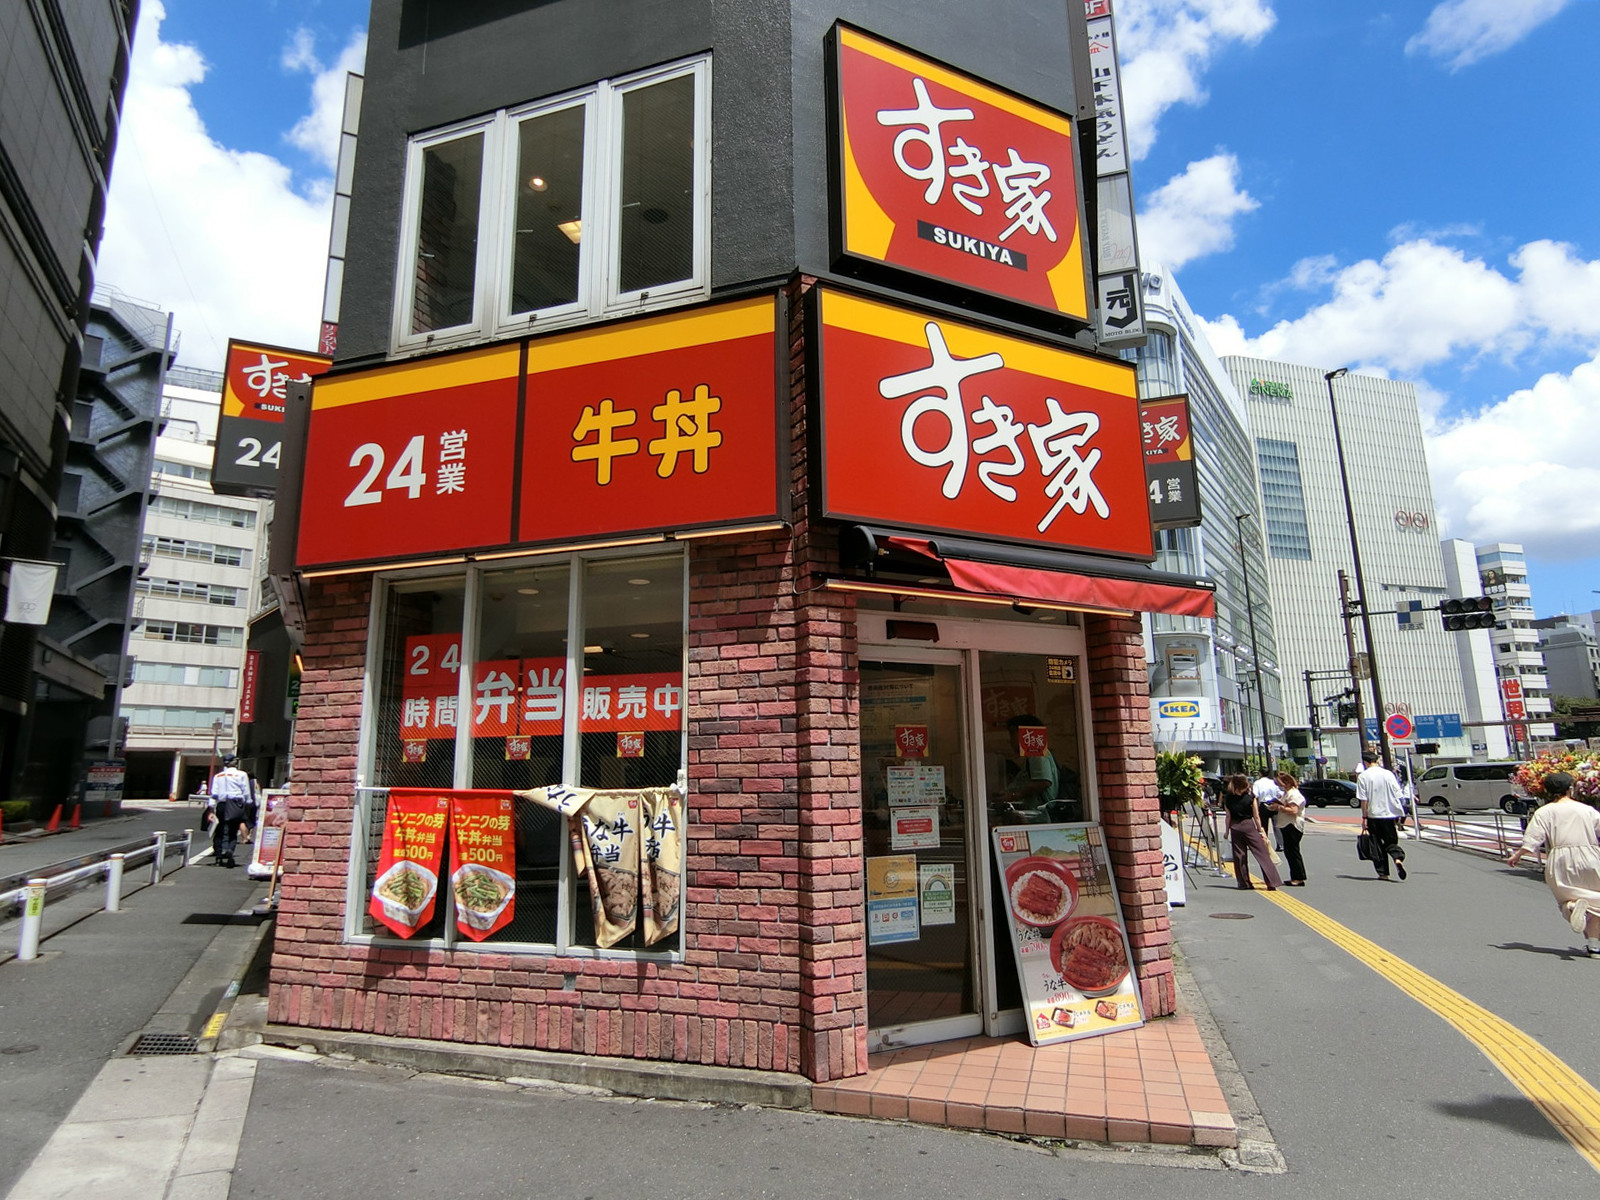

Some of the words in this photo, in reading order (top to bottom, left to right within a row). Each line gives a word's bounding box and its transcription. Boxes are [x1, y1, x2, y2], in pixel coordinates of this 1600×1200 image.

[876, 77, 1057, 242] すき家
[934, 227, 1013, 266] SUKIYA
[1124, 327, 1141, 335] BLDG
[1250, 385, 1293, 399] CINEMA
[570, 383, 723, 486] 牛丼
[878, 321, 1111, 534] すき家
[235, 437, 282, 469] 24
[344, 435, 427, 508] 24
[436, 429, 468, 496] 営業
[1166, 477, 1182, 502] 営業
[410, 644, 460, 675] 24
[475, 667, 565, 724] 弁当
[582, 683, 682, 720] 販売中
[404, 696, 457, 728] 時間
[1163, 705, 1197, 713] IKEA
[900, 728, 925, 747] すき家
[1022, 729, 1044, 748] すき家
[391, 812, 445, 829] ニンニクの芽
[452, 814, 510, 830] ニンニクの芽
[457, 829, 502, 846] 牛丼弁当
[591, 843, 620, 864] 弁当
[1043, 978, 1067, 992] うな牛
